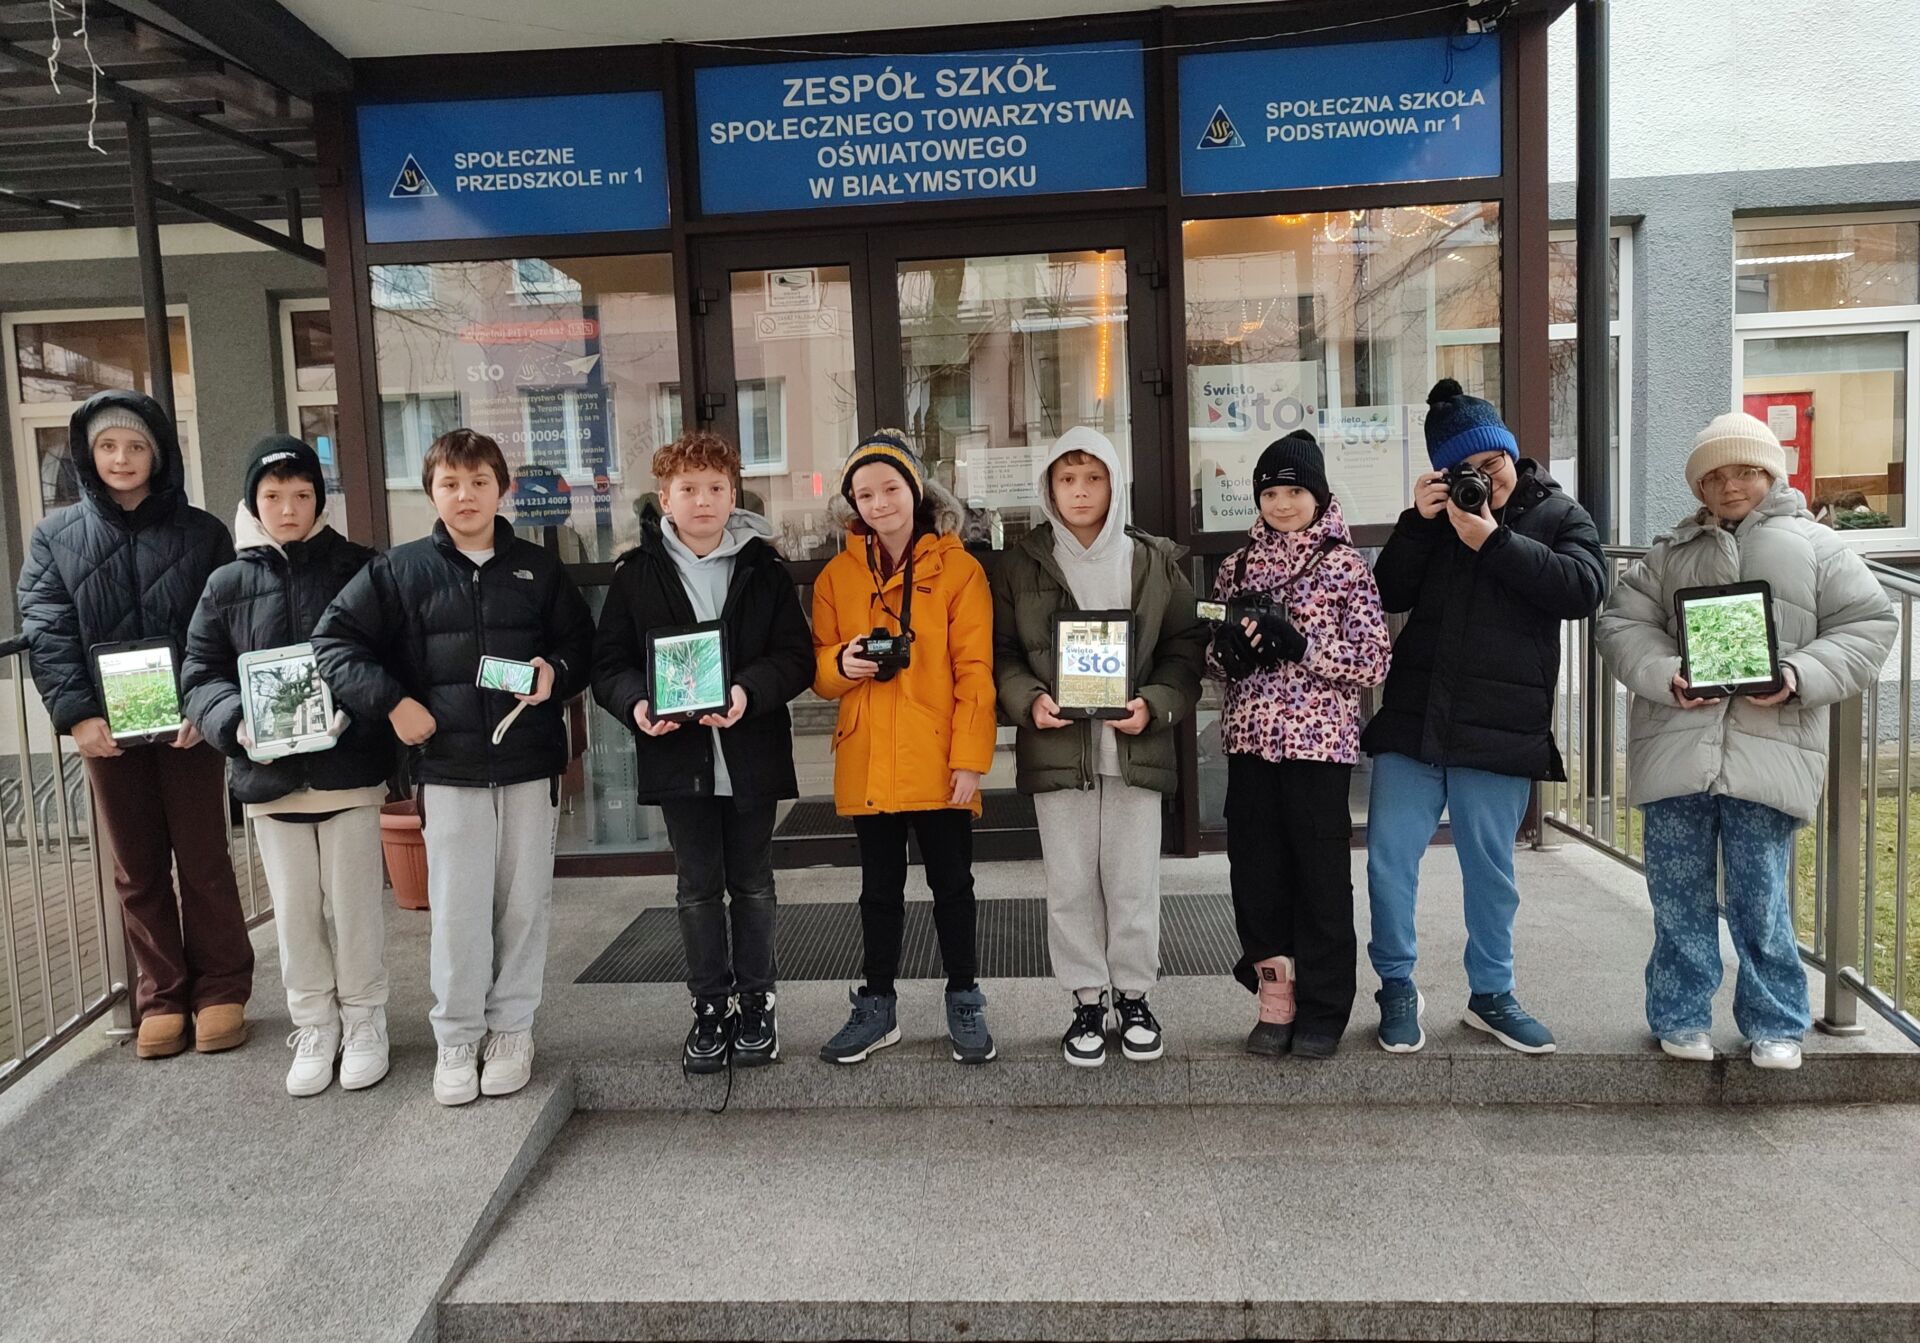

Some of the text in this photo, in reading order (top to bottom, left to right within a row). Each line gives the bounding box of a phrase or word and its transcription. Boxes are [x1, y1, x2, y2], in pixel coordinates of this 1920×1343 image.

[784, 57, 1057, 107] ZESPÓŁ SZKÓŁ
[1266, 88, 1486, 119] SPOŁECZNA SZKOŁA
[710, 98, 1134, 144] SPOŁECZNEGO TOWARZYSTWA
[1266, 113, 1461, 143] PODSTAWOWA nr 1
[454, 148, 575, 170] SPOŁECZNE
[817, 135, 1027, 168] OŚWIATOWEGO
[456, 167, 643, 192] PRZEDSZKOLE nr 1
[808, 165, 1036, 199] W BIAŁYMSTOKU
[467, 361, 505, 382] sto
[1203, 381, 1256, 398] Święto
[585, 401, 598, 411] 171
[1227, 392, 1305, 433] sto
[527, 497, 546, 506] 1213
[548, 496, 568, 505] 4009
[1221, 506, 1258, 517] oświat
[1078, 653, 1121, 673] sto
